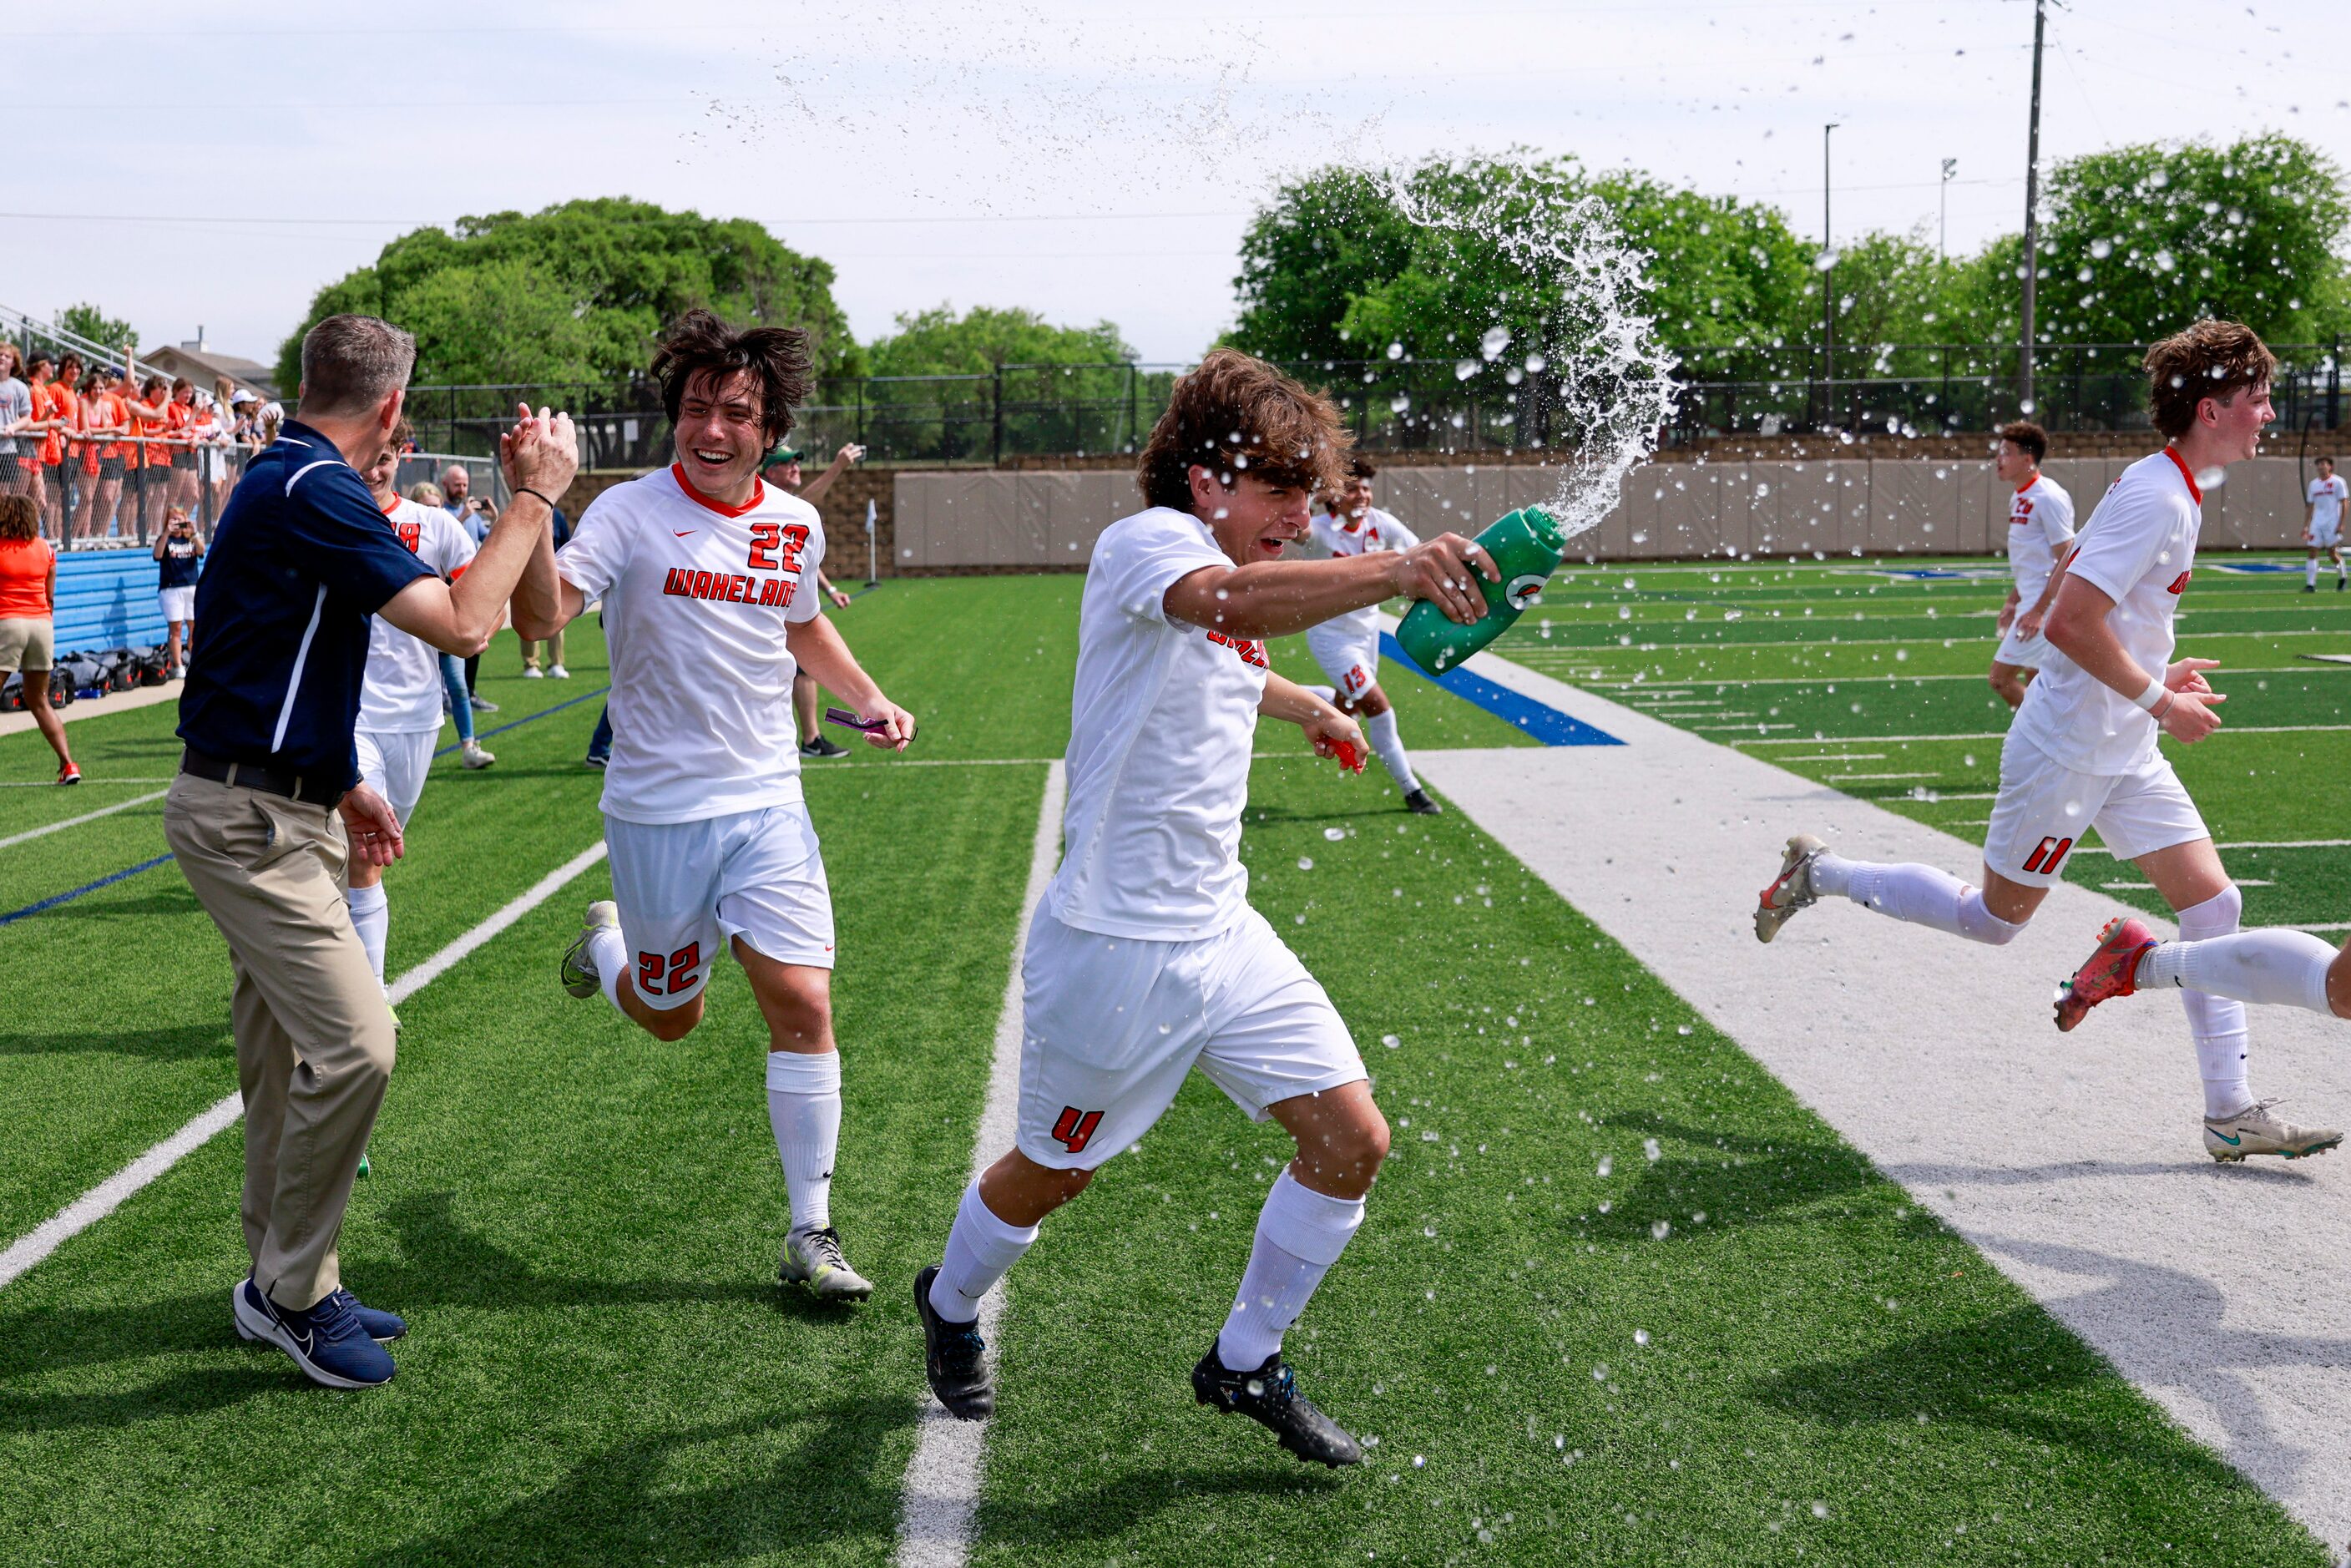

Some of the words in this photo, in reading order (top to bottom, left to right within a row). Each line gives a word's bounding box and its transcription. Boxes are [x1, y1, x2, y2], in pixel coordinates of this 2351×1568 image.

[391, 522, 421, 554] 8
[747, 523, 810, 574] 22
[1342, 664, 1366, 695] 13
[2022, 836, 2073, 874] 11
[638, 940, 700, 995] 22
[1051, 1105, 1105, 1153] 4
